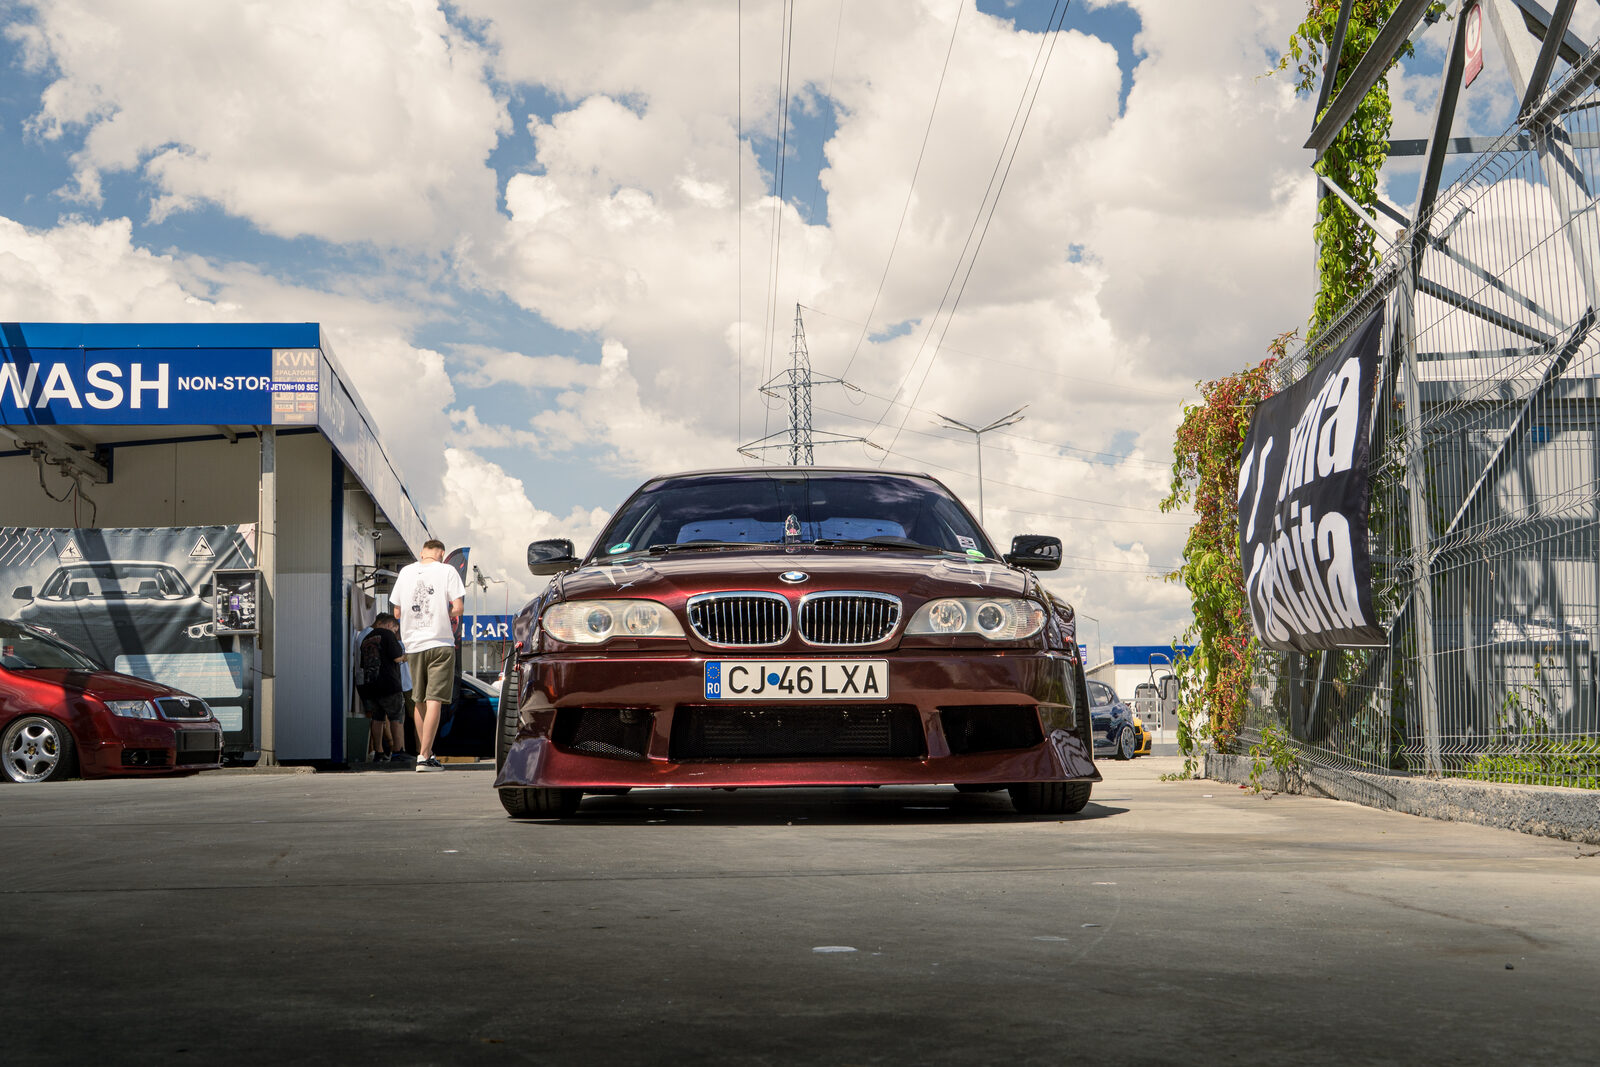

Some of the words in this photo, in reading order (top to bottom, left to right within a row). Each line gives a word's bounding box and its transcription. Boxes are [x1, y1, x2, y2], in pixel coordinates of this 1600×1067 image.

[276, 351, 315, 367] KVN
[0, 362, 169, 410] WASH
[177, 376, 271, 391] NON-STOP
[270, 383, 306, 391] JETON=100
[306, 383, 319, 391] SEC
[470, 622, 509, 638] CAR
[728, 665, 766, 694] CJ
[778, 665, 814, 694] 46
[821, 665, 879, 694] LXA
[707, 682, 720, 695] RO
